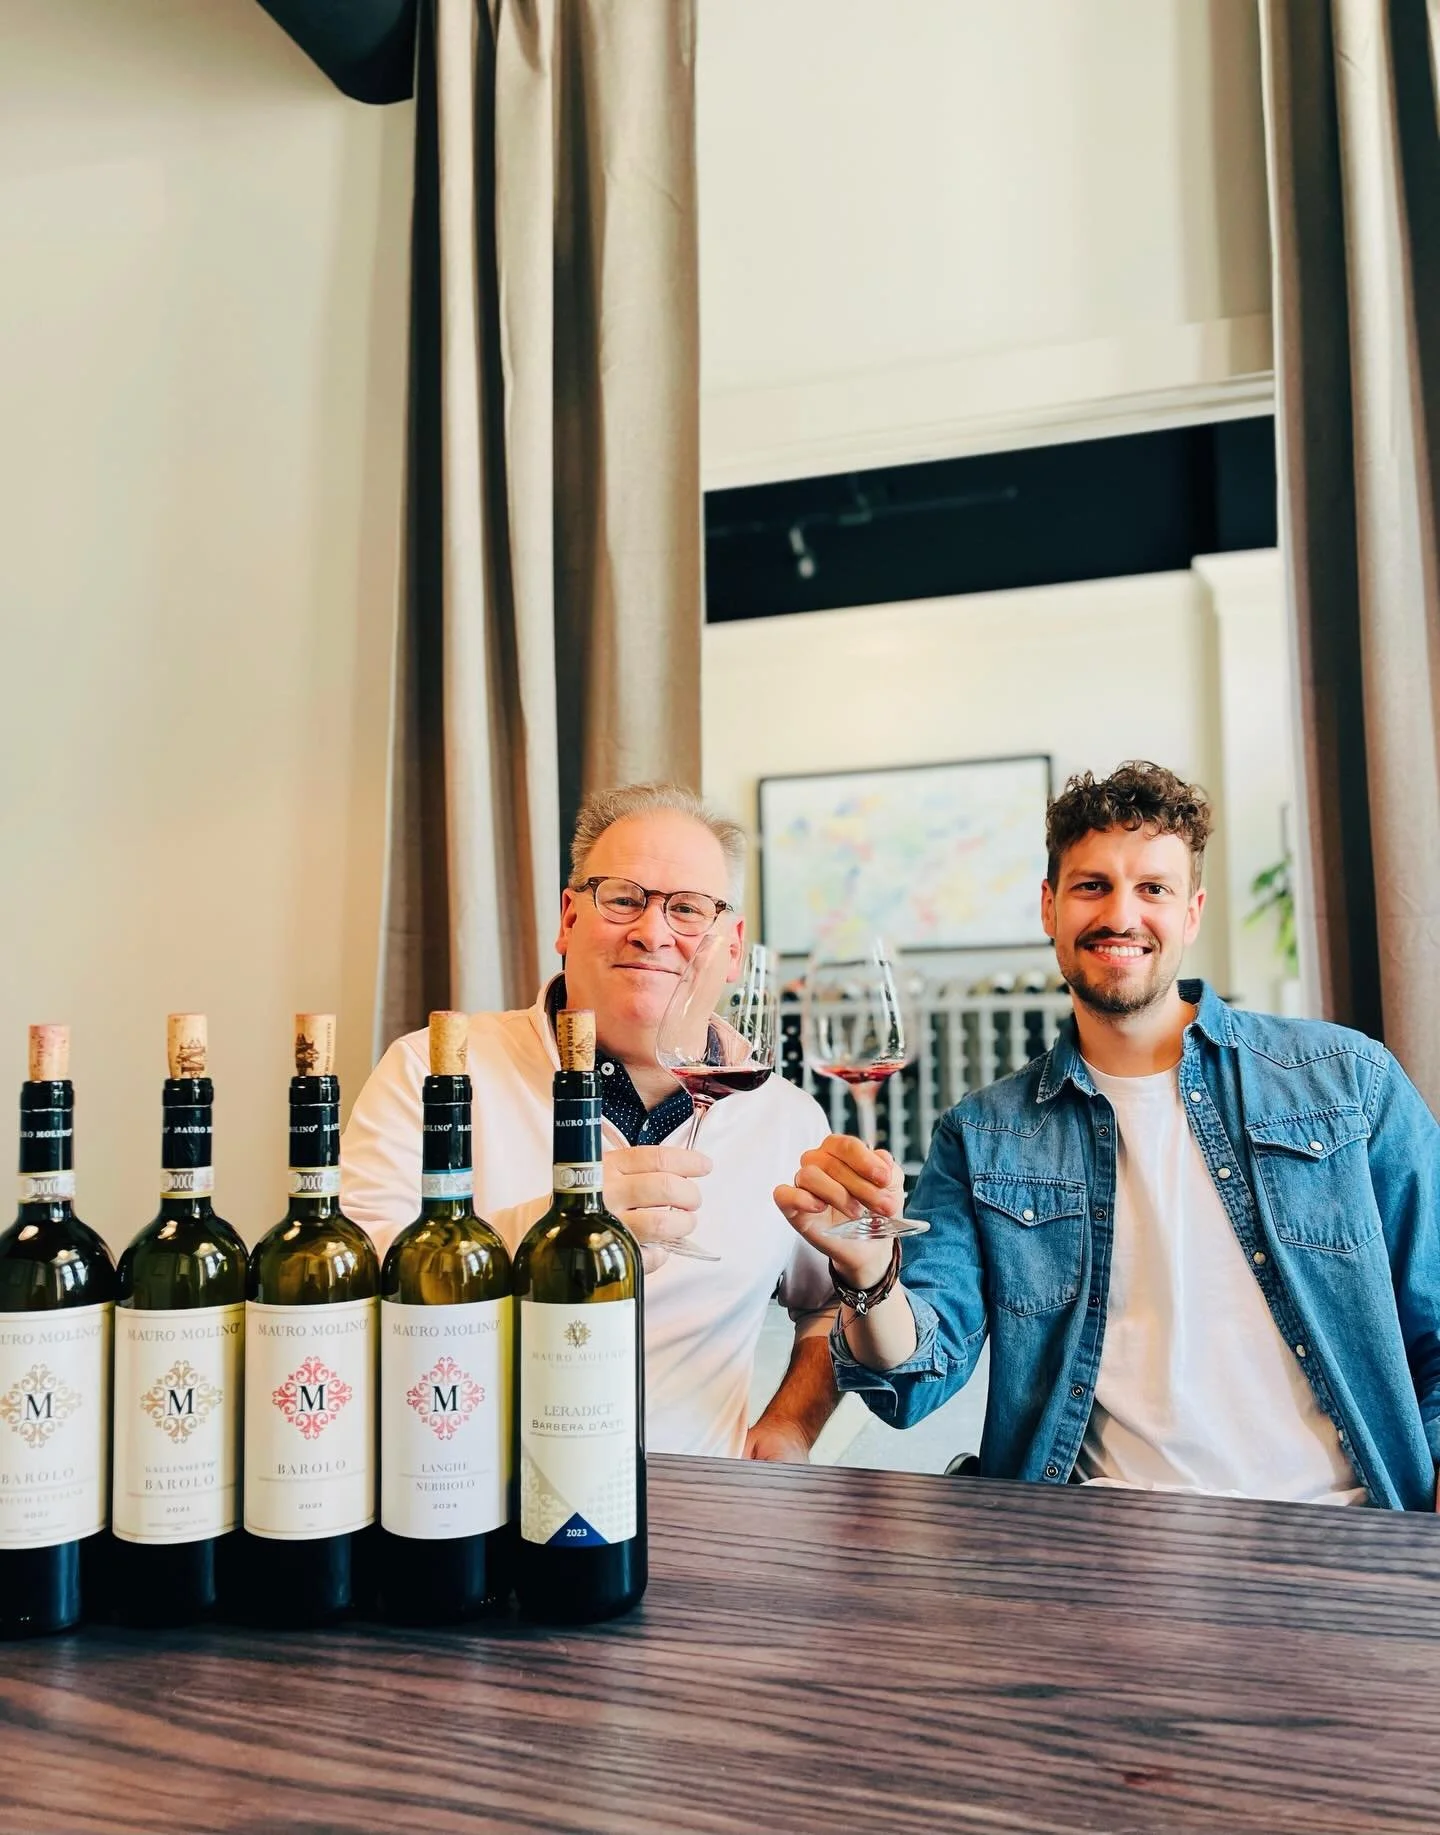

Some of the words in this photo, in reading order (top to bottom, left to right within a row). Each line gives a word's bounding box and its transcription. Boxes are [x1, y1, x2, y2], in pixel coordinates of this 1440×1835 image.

[556, 1119, 583, 1127] MAURO
[127, 1328, 176, 1342] MAURO
[258, 1323, 306, 1337] MAURO
[392, 1323, 440, 1337] MAURO
[0, 1333, 34, 1345] URO
[167, 1387, 195, 1416] M
[299, 1384, 326, 1412] M
[432, 1384, 459, 1412] M
[25, 1392, 54, 1420] M
[532, 1419, 585, 1432] BARBERA
[277, 1459, 346, 1475] BAROLO
[144, 1475, 215, 1490] BAROLO
[566, 1529, 588, 1537] 2023
